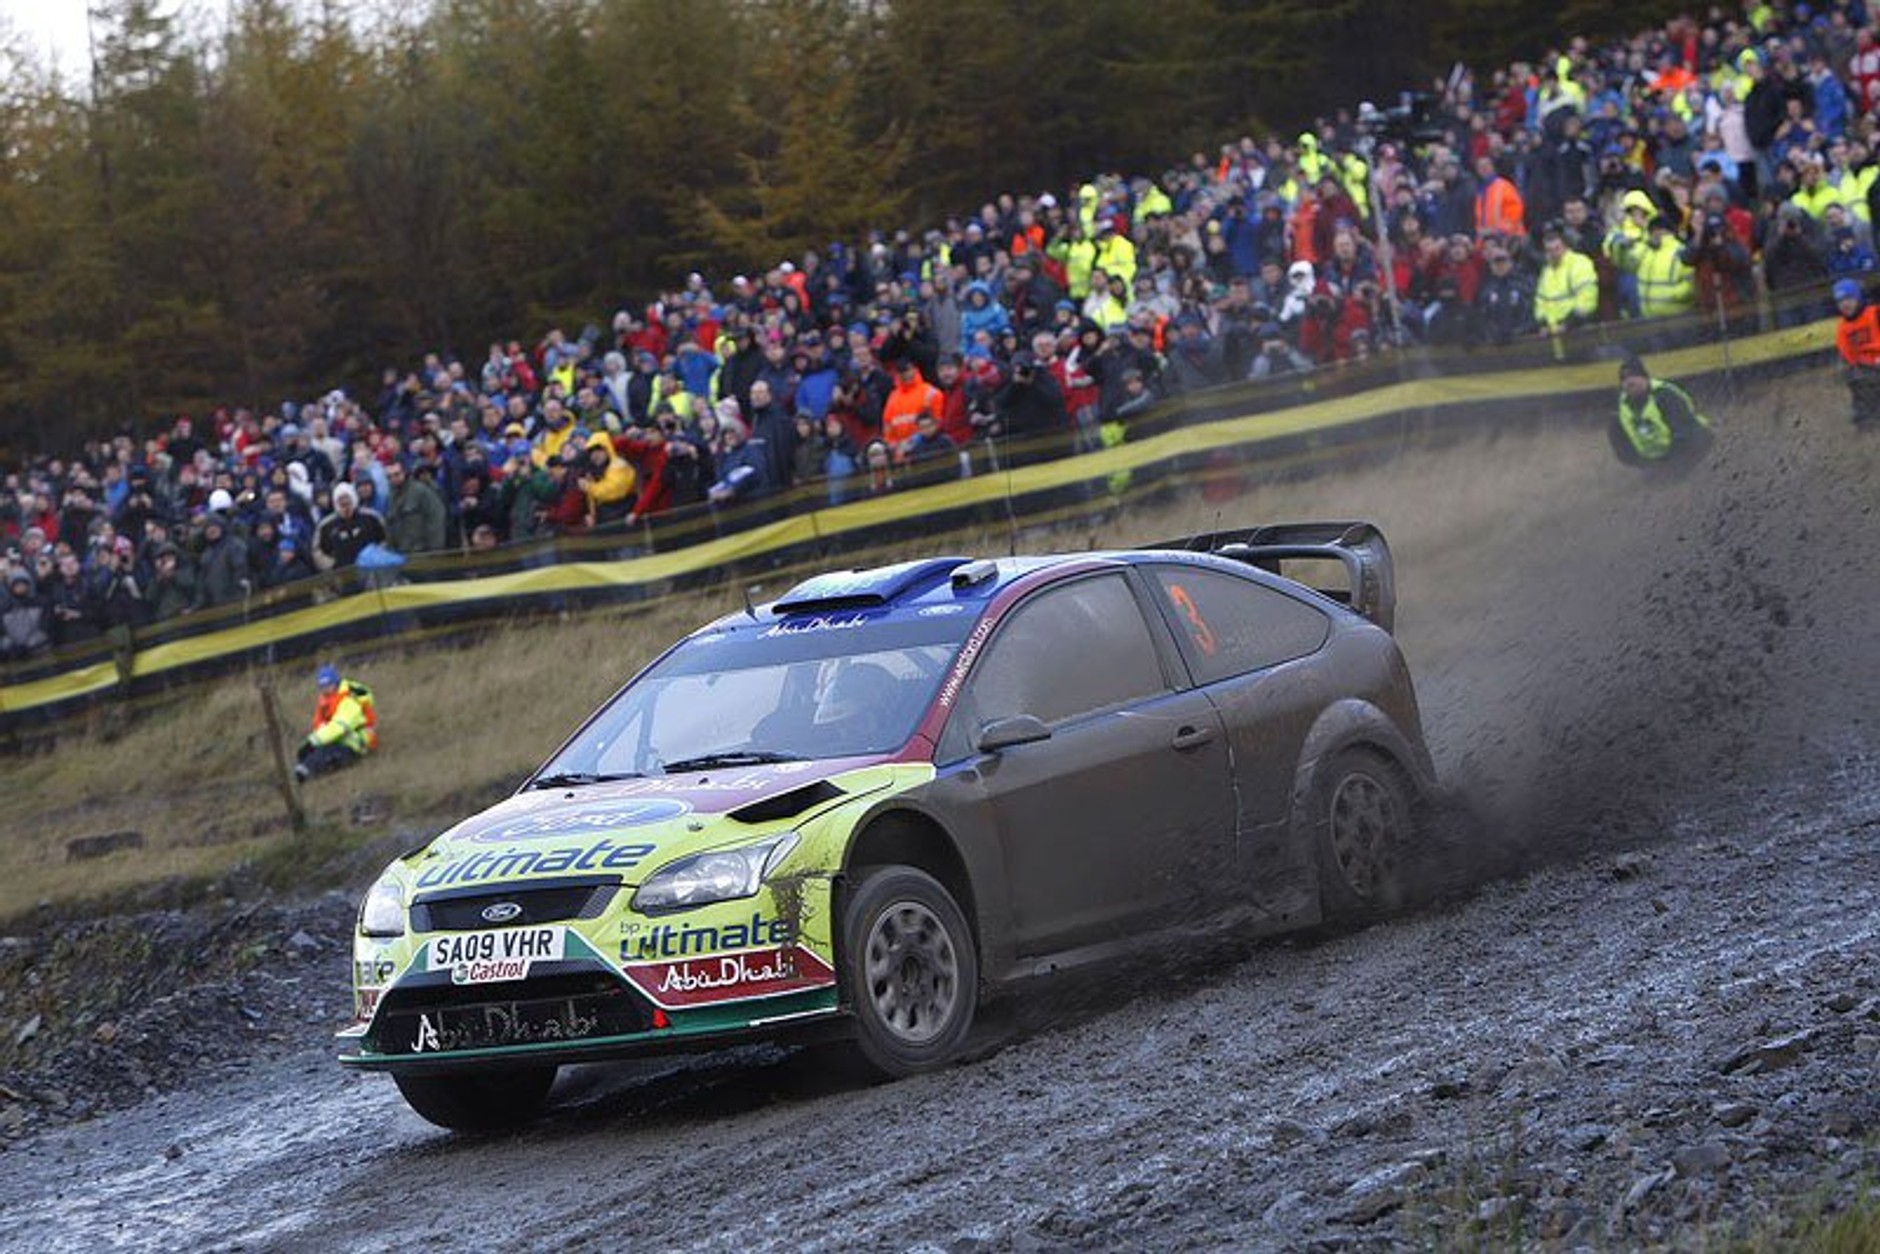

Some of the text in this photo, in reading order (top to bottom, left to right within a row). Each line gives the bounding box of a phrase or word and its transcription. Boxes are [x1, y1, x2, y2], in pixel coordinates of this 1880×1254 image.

[1169, 583, 1217, 657] 3
[416, 838, 657, 889] ultimate
[435, 929, 554, 965] SA09 VHR
[620, 920, 641, 937] bp
[620, 912, 792, 961] ultimate
[469, 959, 526, 981] Castrol
[658, 951, 795, 992] Abu Dhabi
